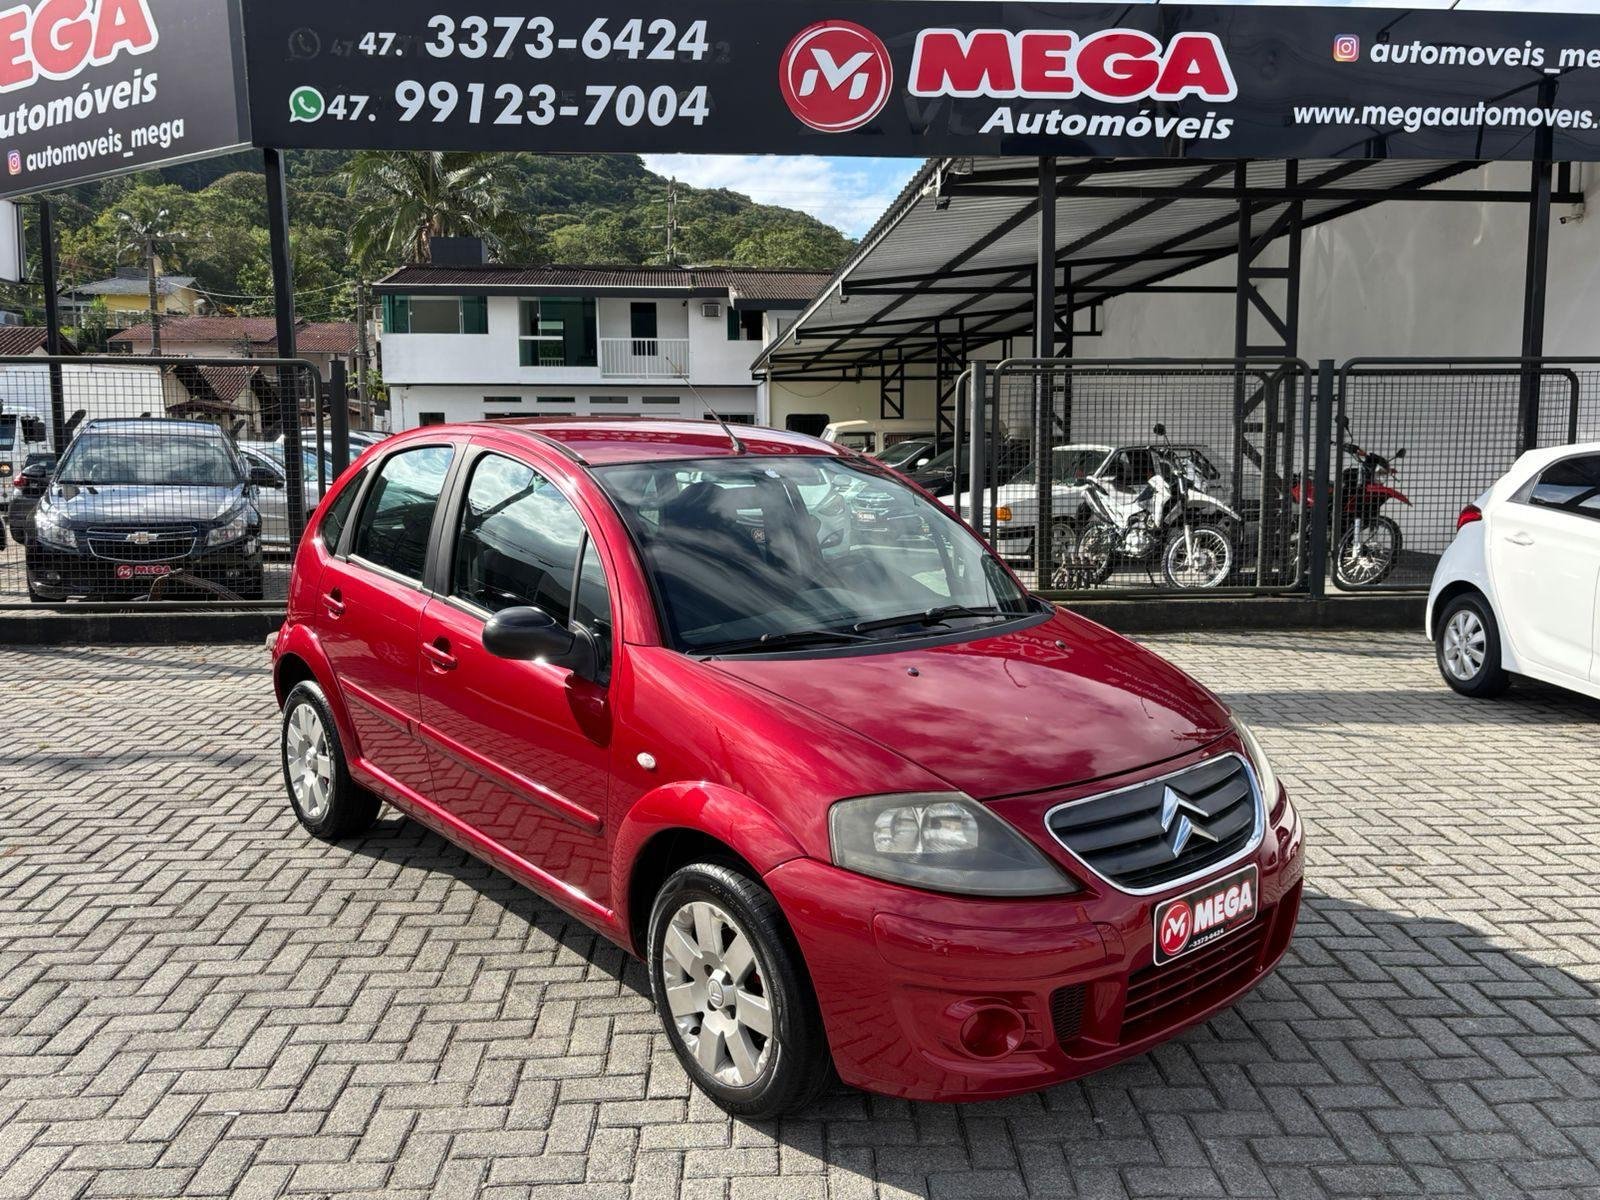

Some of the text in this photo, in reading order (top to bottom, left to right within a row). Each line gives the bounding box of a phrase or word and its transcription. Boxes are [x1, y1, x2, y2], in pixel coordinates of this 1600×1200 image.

[358, 32, 403, 57] 47.
[425, 15, 709, 60] 3373-6424
[907, 28, 1238, 103] MEGA
[0, 68, 158, 139] utomóveis
[327, 80, 710, 126] 47. 99123-7004
[979, 107, 1234, 139] Automóveis
[1293, 101, 1600, 132] www.megaautomoveis.
[27, 119, 184, 171] automoveis_mega
[1193, 881, 1252, 934] MEGA
